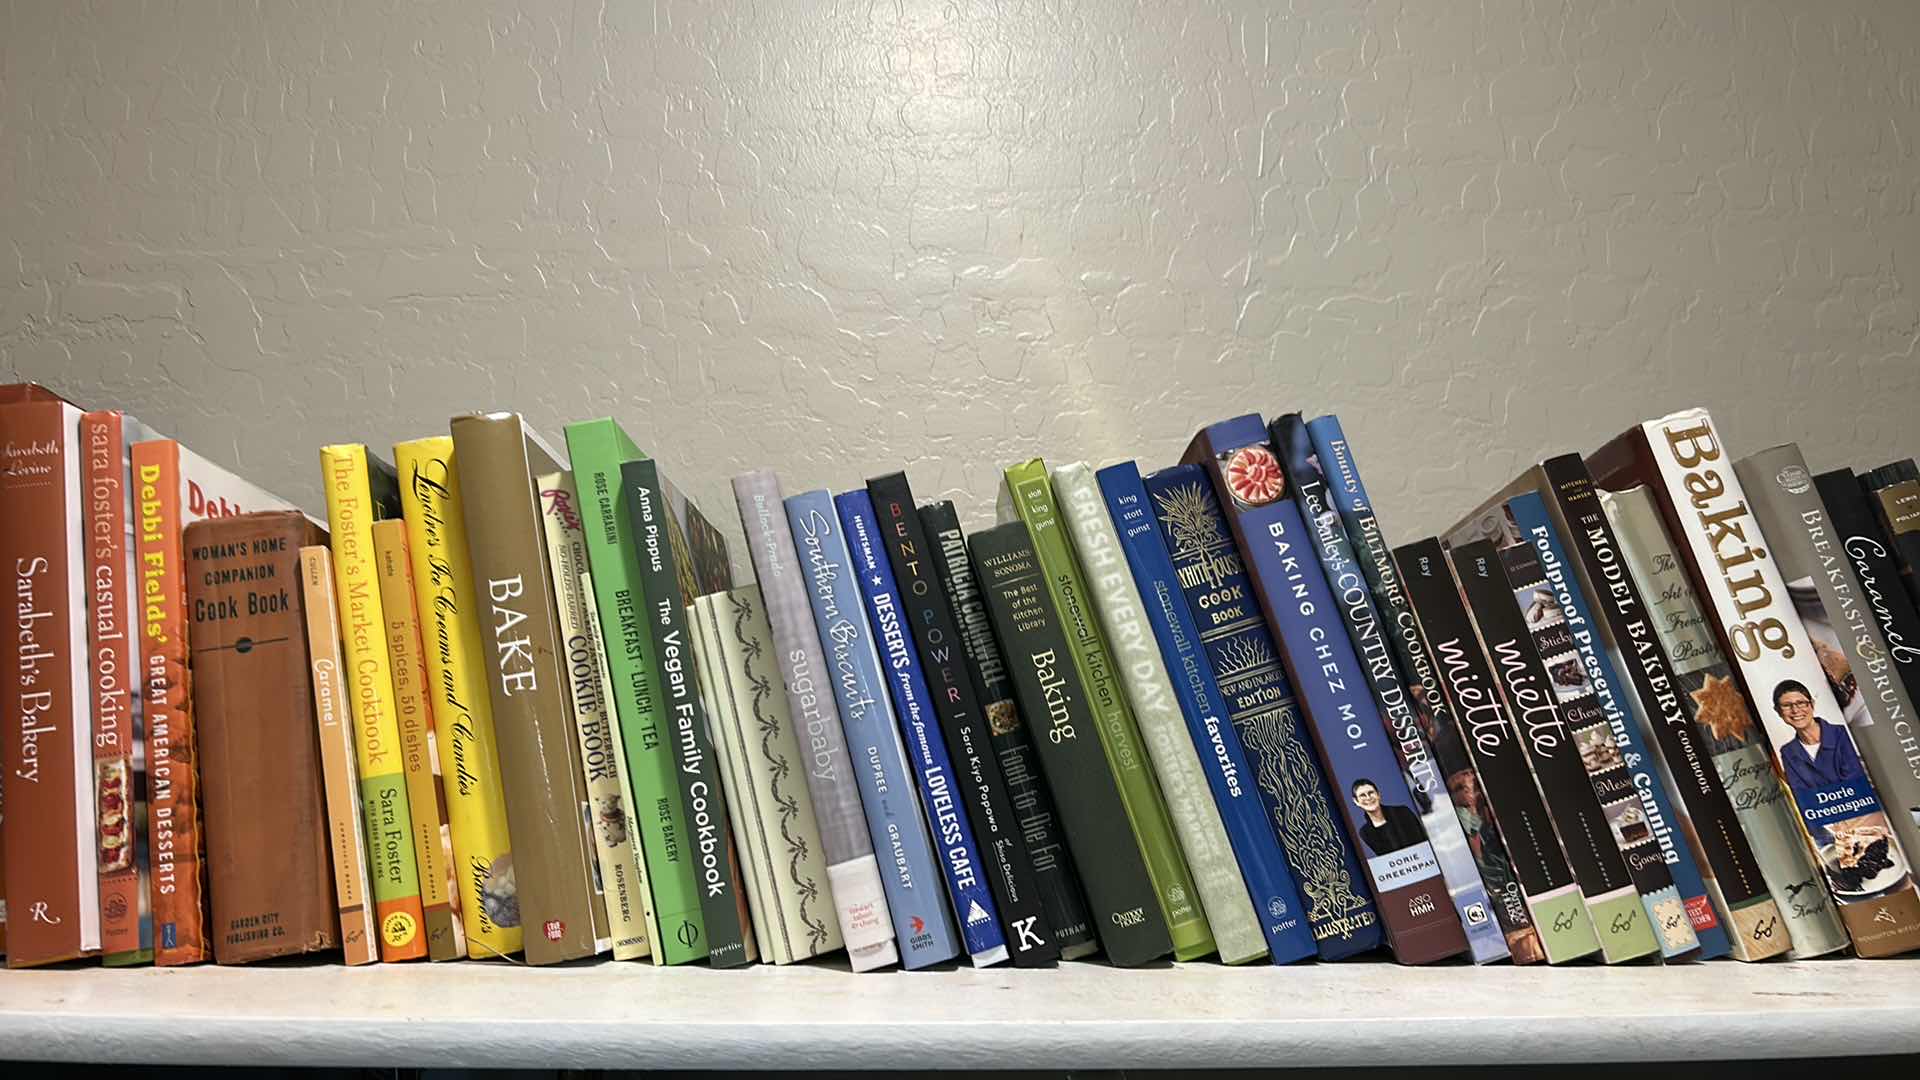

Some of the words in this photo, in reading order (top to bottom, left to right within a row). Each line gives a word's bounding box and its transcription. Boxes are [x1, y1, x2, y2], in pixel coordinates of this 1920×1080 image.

[91, 423, 110, 470] sara
[1329, 439, 1359, 495] Bounty
[333, 454, 355, 491] The
[593, 472, 607, 496] ROSE
[93, 476, 120, 559] foster's
[140, 463, 164, 545] Debbi
[638, 486, 653, 522] Anna
[1031, 502, 1049, 515] king
[1118, 494, 1138, 506] king
[1123, 508, 1144, 521] stott
[1353, 496, 1370, 513] of
[1580, 513, 1600, 524] THE
[192, 541, 248, 561] WOMAN'S
[252, 537, 288, 557] HOME
[338, 497, 366, 577] Foster's
[645, 525, 663, 572] Pippus
[853, 515, 877, 570] HUNTSMAN
[1035, 518, 1055, 532] gunst
[1127, 523, 1151, 538] gunst
[1662, 416, 1797, 664] Baking
[204, 564, 276, 586] COMPANION
[429, 552, 454, 586] Ice
[993, 562, 1033, 578] SONOMA
[1358, 516, 1406, 607] BILTMORE
[1417, 556, 1433, 578] Ray
[1474, 556, 1489, 579] Ray
[1586, 525, 1637, 616] MODEL
[1651, 554, 1676, 576] The
[1801, 509, 1872, 647] BREAKFASTS
[95, 565, 124, 642] casual
[144, 550, 168, 645] Fields'
[195, 603, 239, 623] Cook
[248, 591, 290, 616] Book
[658, 598, 671, 625] The
[799, 509, 840, 620] Southern
[829, 617, 876, 722] Biscuits
[889, 503, 929, 597] BENTO
[922, 608, 962, 704] POWER
[938, 528, 979, 601] PATRICIA
[961, 600, 1007, 689] CORNWELL
[1003, 589, 1019, 600] The
[1020, 583, 1038, 596] Best
[1011, 600, 1025, 610] of
[1025, 596, 1037, 606] the
[1012, 607, 1044, 621] Kitchen
[1074, 486, 1111, 568] FRESH
[1103, 572, 1145, 656] EVERY
[1134, 656, 1172, 713] DAY
[1198, 585, 1244, 609] COOK
[1210, 605, 1245, 625] BOOK
[1844, 535, 1920, 665] Caramel
[16, 556, 55, 687] Sarabeth's
[347, 580, 373, 655] Market
[391, 619, 406, 631] 5
[433, 586, 458, 665] Creams
[488, 574, 538, 697] BAKE
[615, 589, 644, 662] BREAKFAST
[873, 592, 911, 669] DESSERTS
[1017, 619, 1046, 633] Library
[1268, 521, 1315, 617] BAKING
[1309, 627, 1346, 694] CHEZ
[1338, 703, 1368, 751] MOI
[1300, 480, 1323, 515] Lee
[1312, 511, 1349, 573] Bailey's
[1337, 571, 1393, 684] COUNTRY
[1380, 685, 1439, 794] DESSERTS
[150, 654, 168, 706] GREAT
[392, 636, 410, 691] spices,
[568, 635, 598, 716] COOKIE
[663, 630, 687, 698] Vegan
[897, 670, 914, 702] from
[1058, 574, 1098, 648] stonewall
[1085, 648, 1114, 708] kitchen
[1108, 709, 1138, 771] harvest
[1396, 611, 1447, 716] COOKBOOK
[1626, 619, 1688, 726] BAKERY
[96, 647, 126, 748] cooking
[313, 658, 338, 727] Caramel
[357, 657, 390, 766] Cookbook
[401, 695, 416, 714] 50
[445, 667, 469, 711] and
[631, 670, 653, 715] LUNCH
[906, 701, 921, 722] the
[1031, 648, 1077, 745] Baking
[1152, 579, 1192, 656] stonewall
[1182, 653, 1212, 714] kitchen
[1204, 715, 1243, 799] favorites
[1236, 686, 1282, 710] EDITION
[1438, 638, 1510, 758] miette
[1494, 639, 1567, 758] miette
[1531, 524, 1586, 628] Foolproof
[1573, 629, 1632, 749] Preserving
[1624, 751, 1642, 769] &
[1633, 772, 1680, 865] Canning
[16, 690, 57, 784] Bakery
[641, 722, 660, 751] TEA
[789, 648, 836, 782] sugarbaby
[151, 712, 171, 801] AMERICAN
[403, 719, 422, 774] dishes
[450, 712, 478, 798] Candies
[581, 721, 609, 783] BOOK
[676, 704, 705, 775] Family
[911, 718, 934, 766] famous
[1677, 728, 1713, 797] COOKBOOK
[960, 725, 974, 755] Sara
[969, 755, 984, 783] Kiyo
[979, 783, 998, 833] Popowa
[1000, 744, 1038, 787] Food
[379, 788, 398, 826] Sara
[656, 797, 670, 822] ROSE
[867, 745, 888, 793] DUPREE
[887, 823, 913, 890] GRAUBART
[924, 765, 964, 846] LOVELESS
[1804, 795, 1876, 822] Greenspan
[1816, 785, 1856, 806] Dorie
[156, 807, 176, 895] DESSERTS
[662, 825, 680, 863] BAKERY
[689, 781, 726, 898] Cookbook
[1021, 811, 1053, 843] Die
[384, 830, 403, 884] Foster
[949, 845, 977, 891] CAFE
[1031, 842, 1062, 874] For
[1377, 859, 1436, 883] GREENSPAN
[1388, 853, 1420, 869] DORIE
[614, 863, 632, 922] ROSENBERG
[1003, 863, 1019, 903] Delicious
[261, 913, 280, 924] CITY
[1054, 923, 1087, 939] PUTNAM
[1171, 905, 1192, 919] potter
[1272, 918, 1297, 936] potter
[1409, 901, 1436, 918] HMH
[710, 942, 744, 956] appetite
[1011, 915, 1046, 953] K
